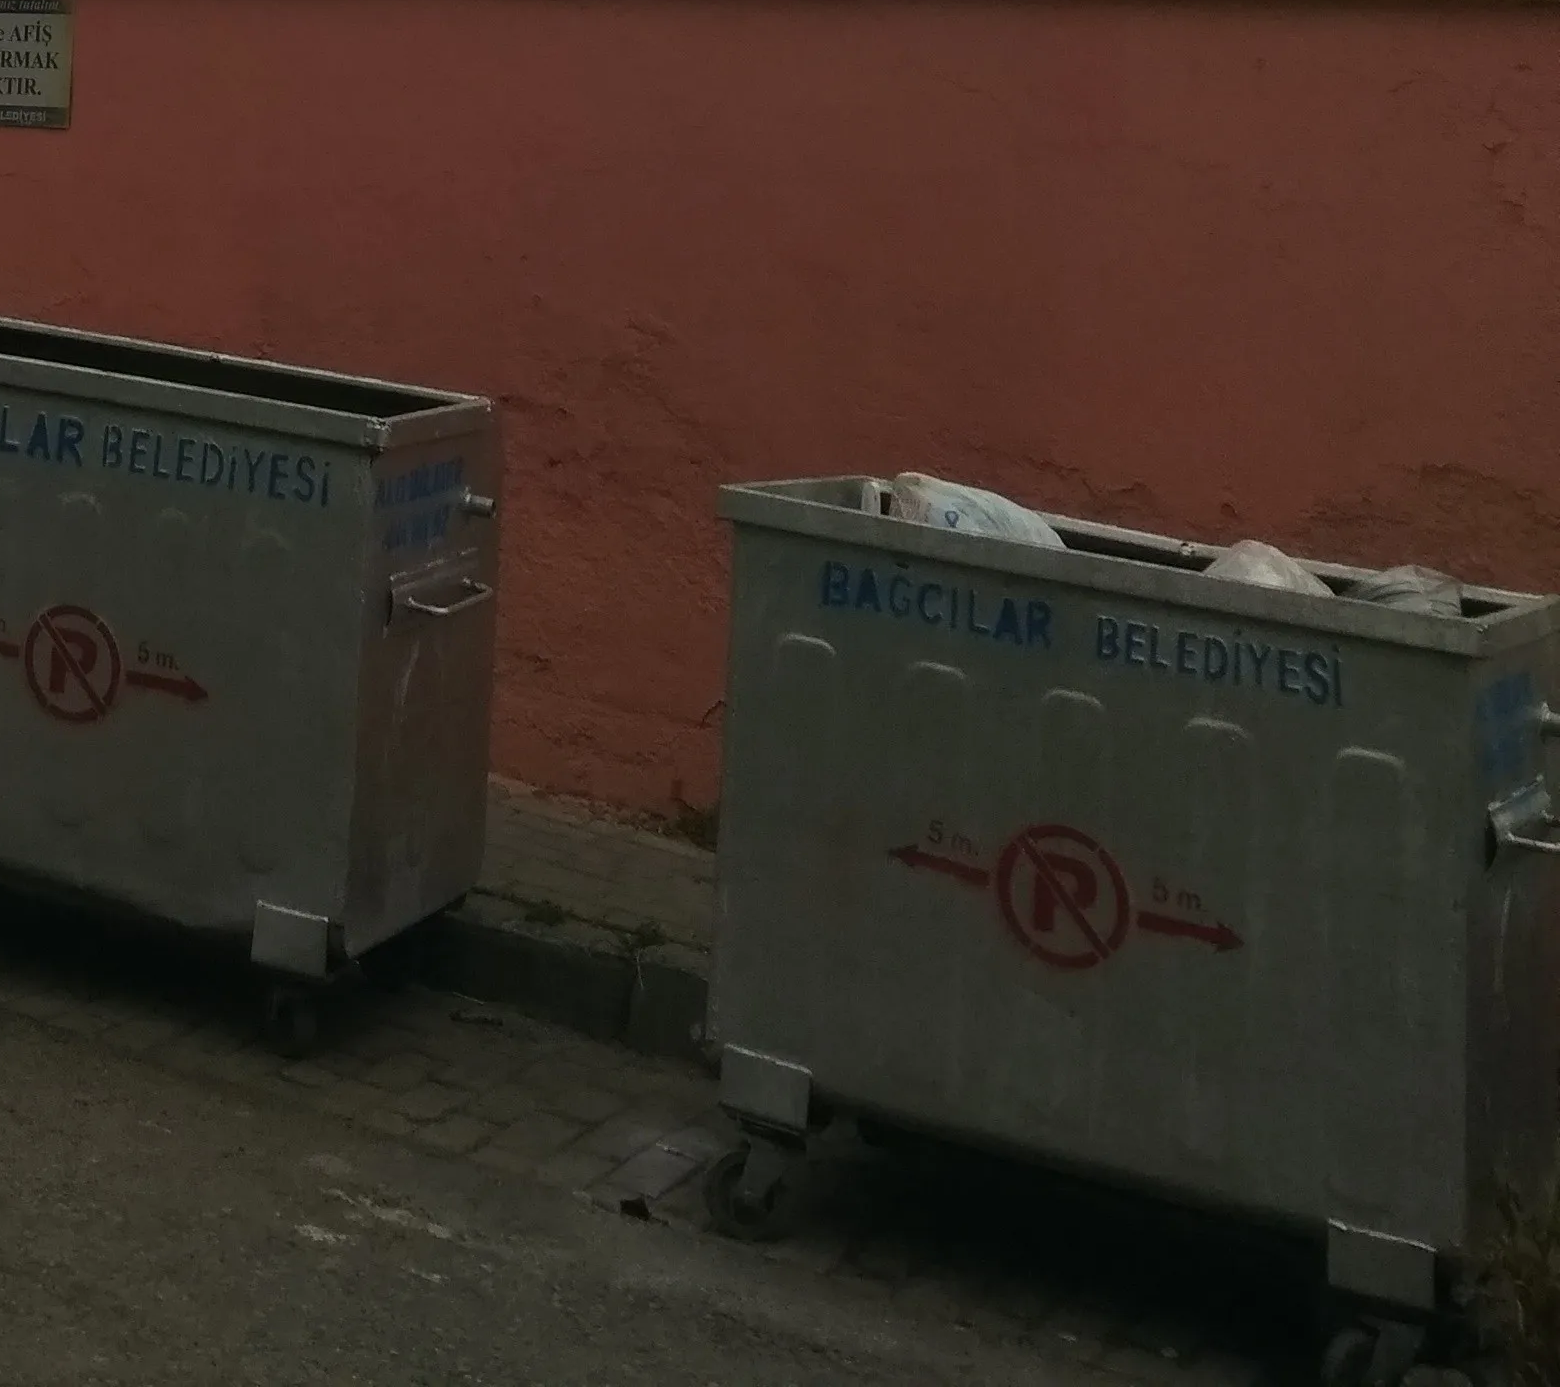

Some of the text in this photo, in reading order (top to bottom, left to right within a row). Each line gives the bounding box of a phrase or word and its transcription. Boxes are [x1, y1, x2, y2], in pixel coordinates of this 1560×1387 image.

[7, 20, 53, 46] AFİŞ
[101, 423, 331, 508] BELEDİYESİ
[820, 560, 1344, 707] BAĞCILAR BELEDİYESİ
